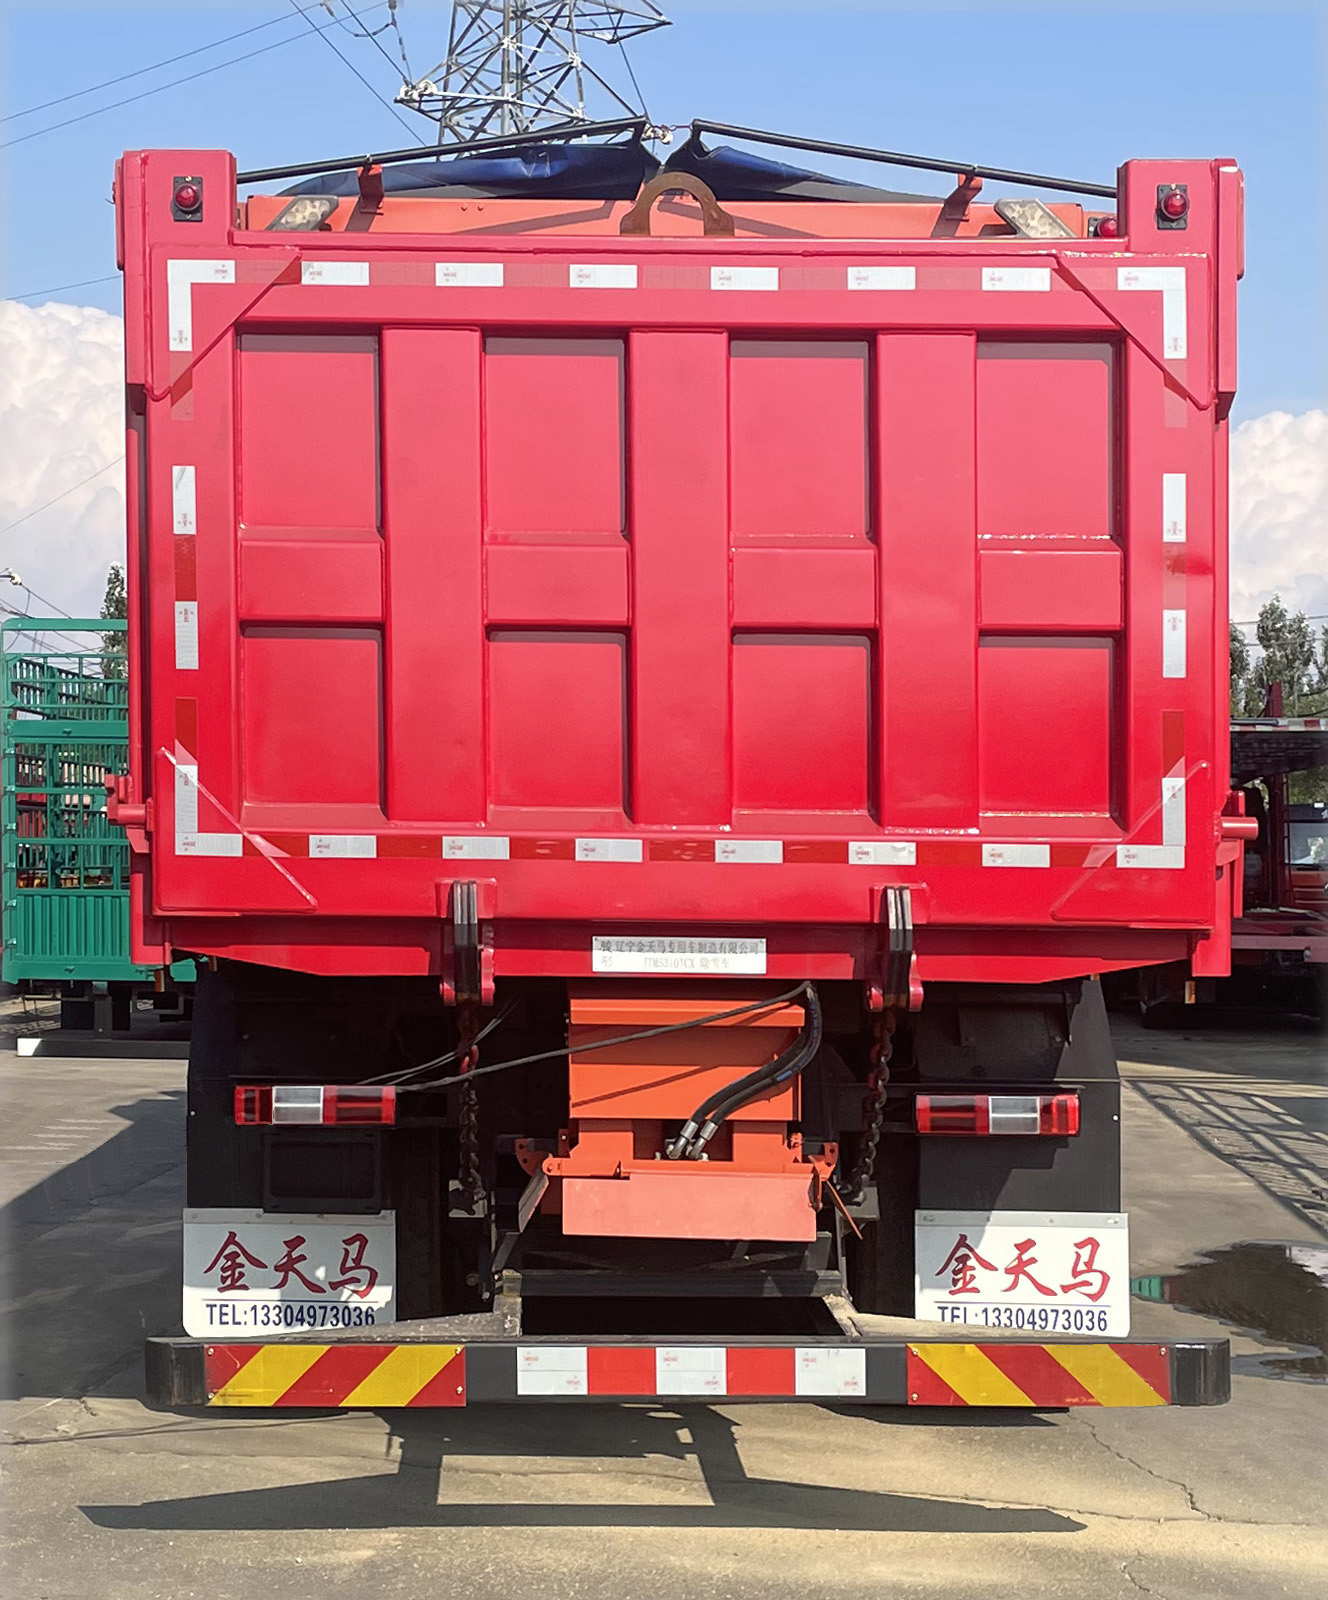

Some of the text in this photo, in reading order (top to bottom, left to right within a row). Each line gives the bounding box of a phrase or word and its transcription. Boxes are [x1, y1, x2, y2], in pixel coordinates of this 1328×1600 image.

[204, 1231, 379, 1299] 金天马
[935, 1233, 1110, 1302] 金天马
[206, 1304, 375, 1327] TEL:13304973036
